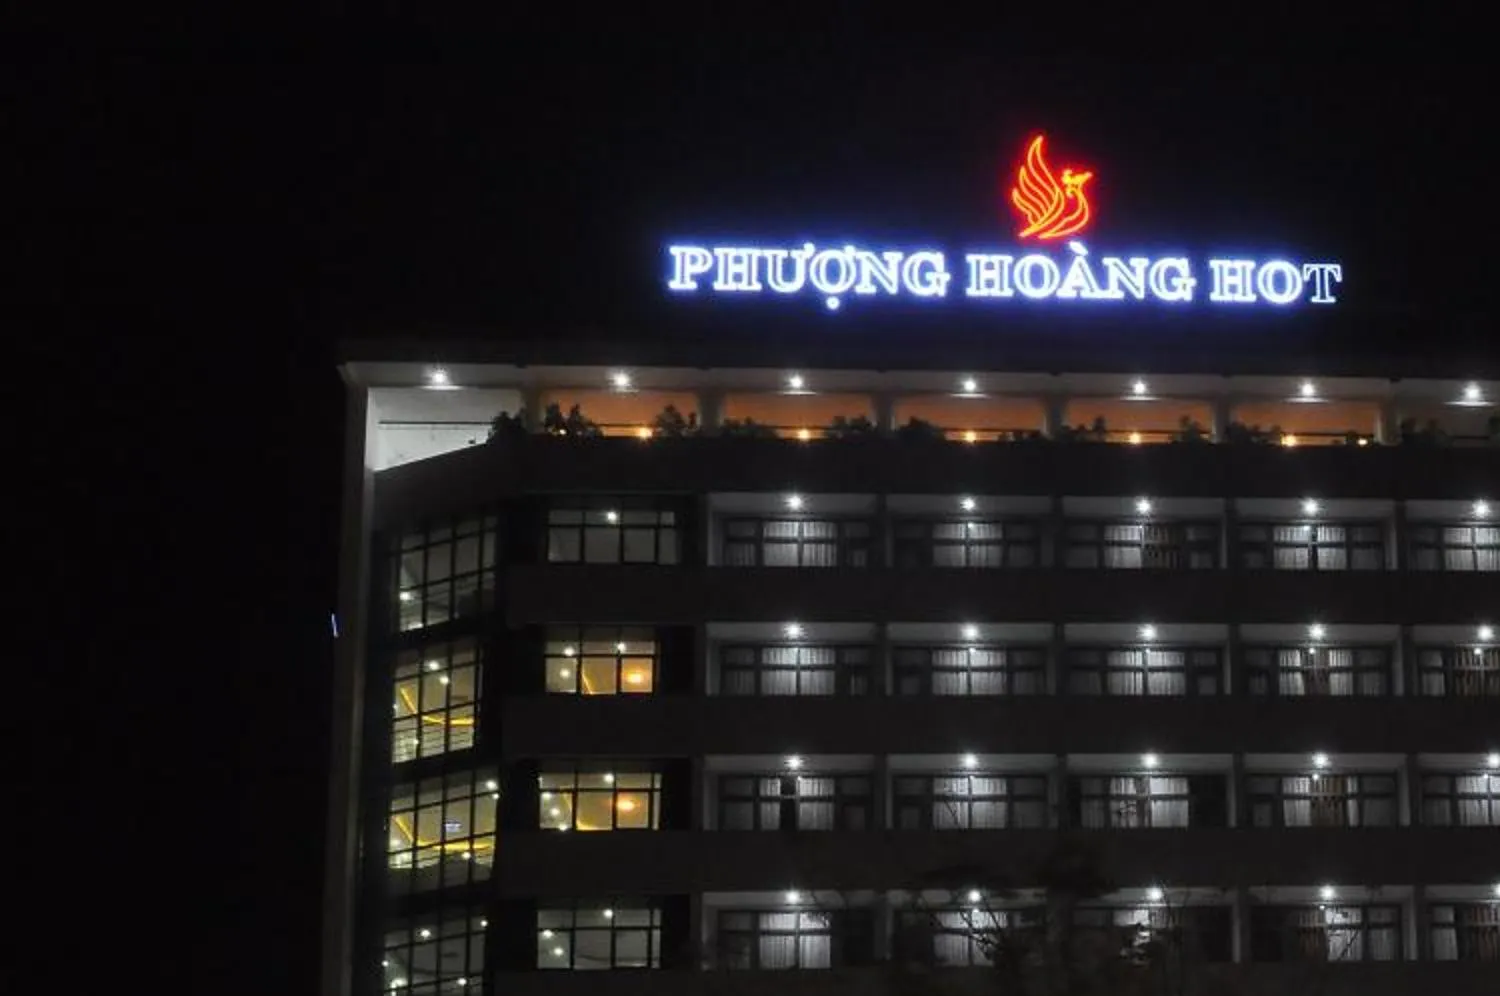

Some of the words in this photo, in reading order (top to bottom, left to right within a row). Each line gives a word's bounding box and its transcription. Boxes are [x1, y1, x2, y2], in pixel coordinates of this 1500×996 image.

[667, 241, 951, 310] PHƯỢNG
[965, 240, 1197, 302] HOÀNG
[1208, 258, 1343, 304] HOT
